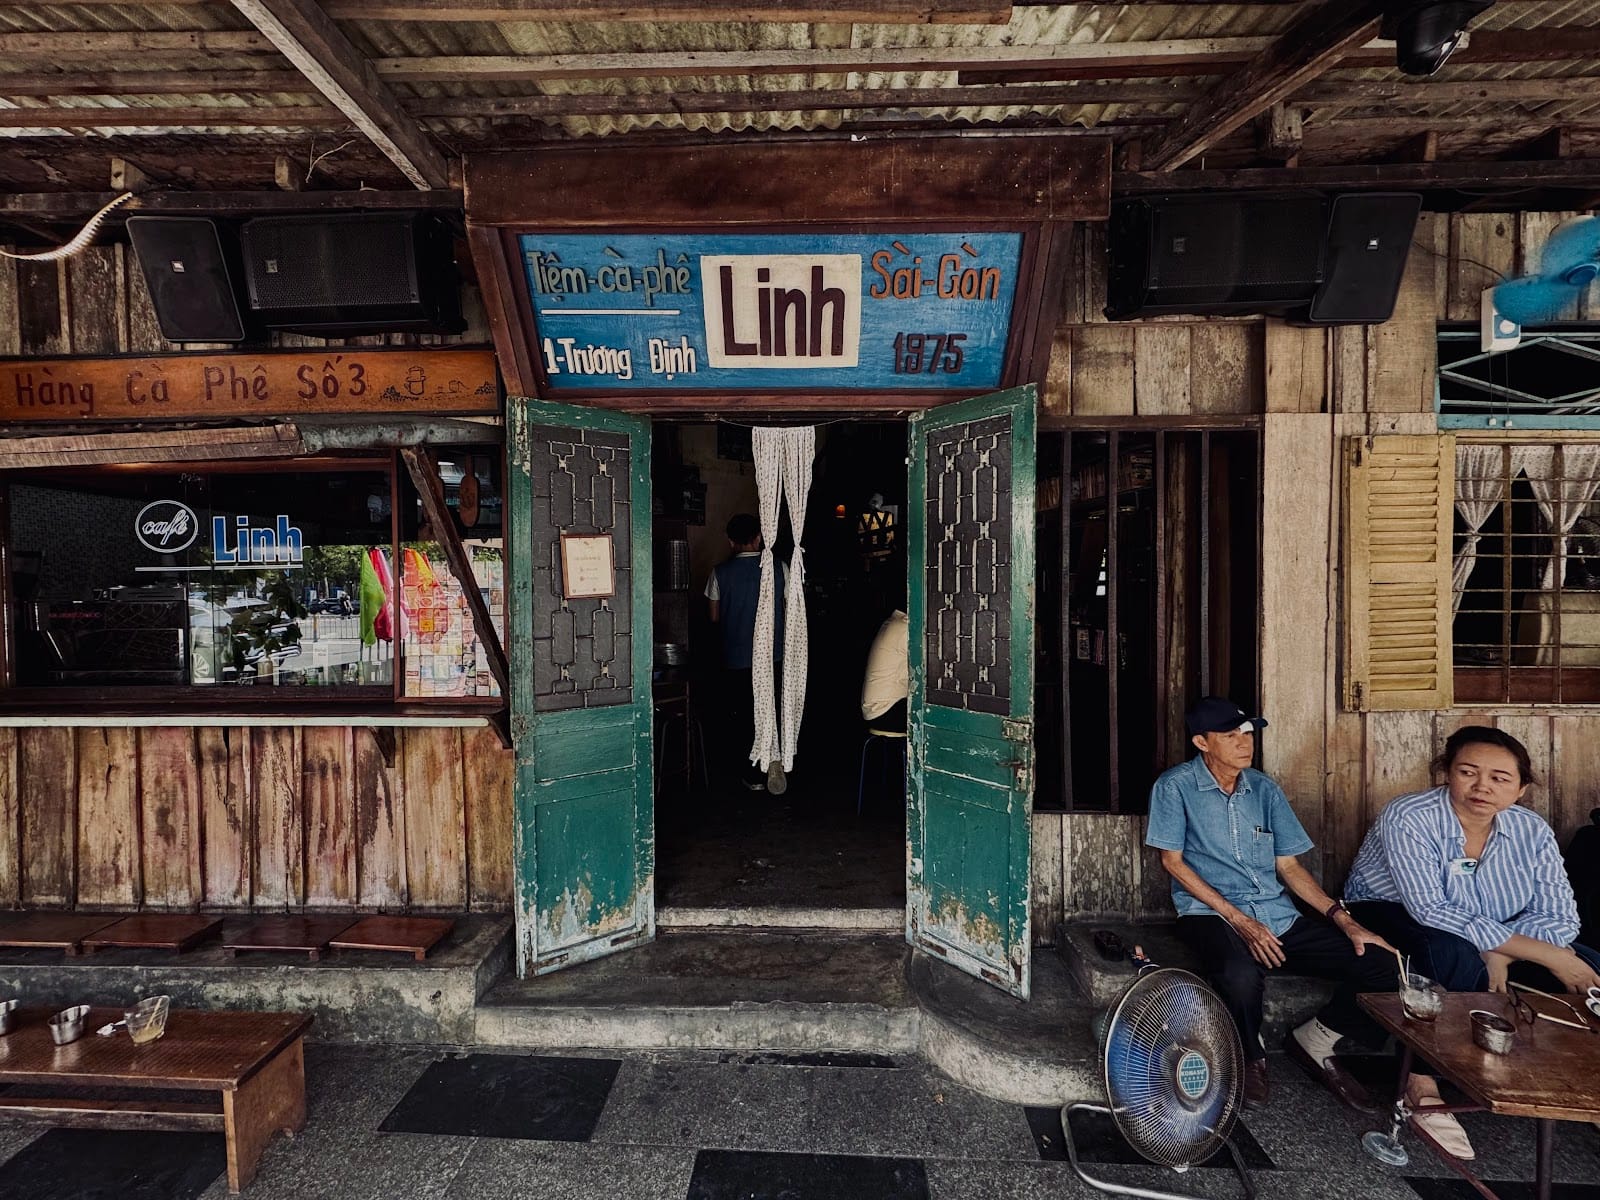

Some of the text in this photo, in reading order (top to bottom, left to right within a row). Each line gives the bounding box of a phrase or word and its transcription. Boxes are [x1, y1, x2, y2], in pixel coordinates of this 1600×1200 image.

[526, 246, 692, 307] Tiệm-cà-phê
[870, 240, 1001, 300] Sài-Gòn
[720, 265, 846, 357] Linh
[649, 336, 697, 381] Định
[893, 332, 968, 375] 1975
[15, 367, 95, 416] Hàng
[126, 363, 170, 405] Cà
[204, 364, 269, 401] Phê
[212, 514, 304, 564] Linh
